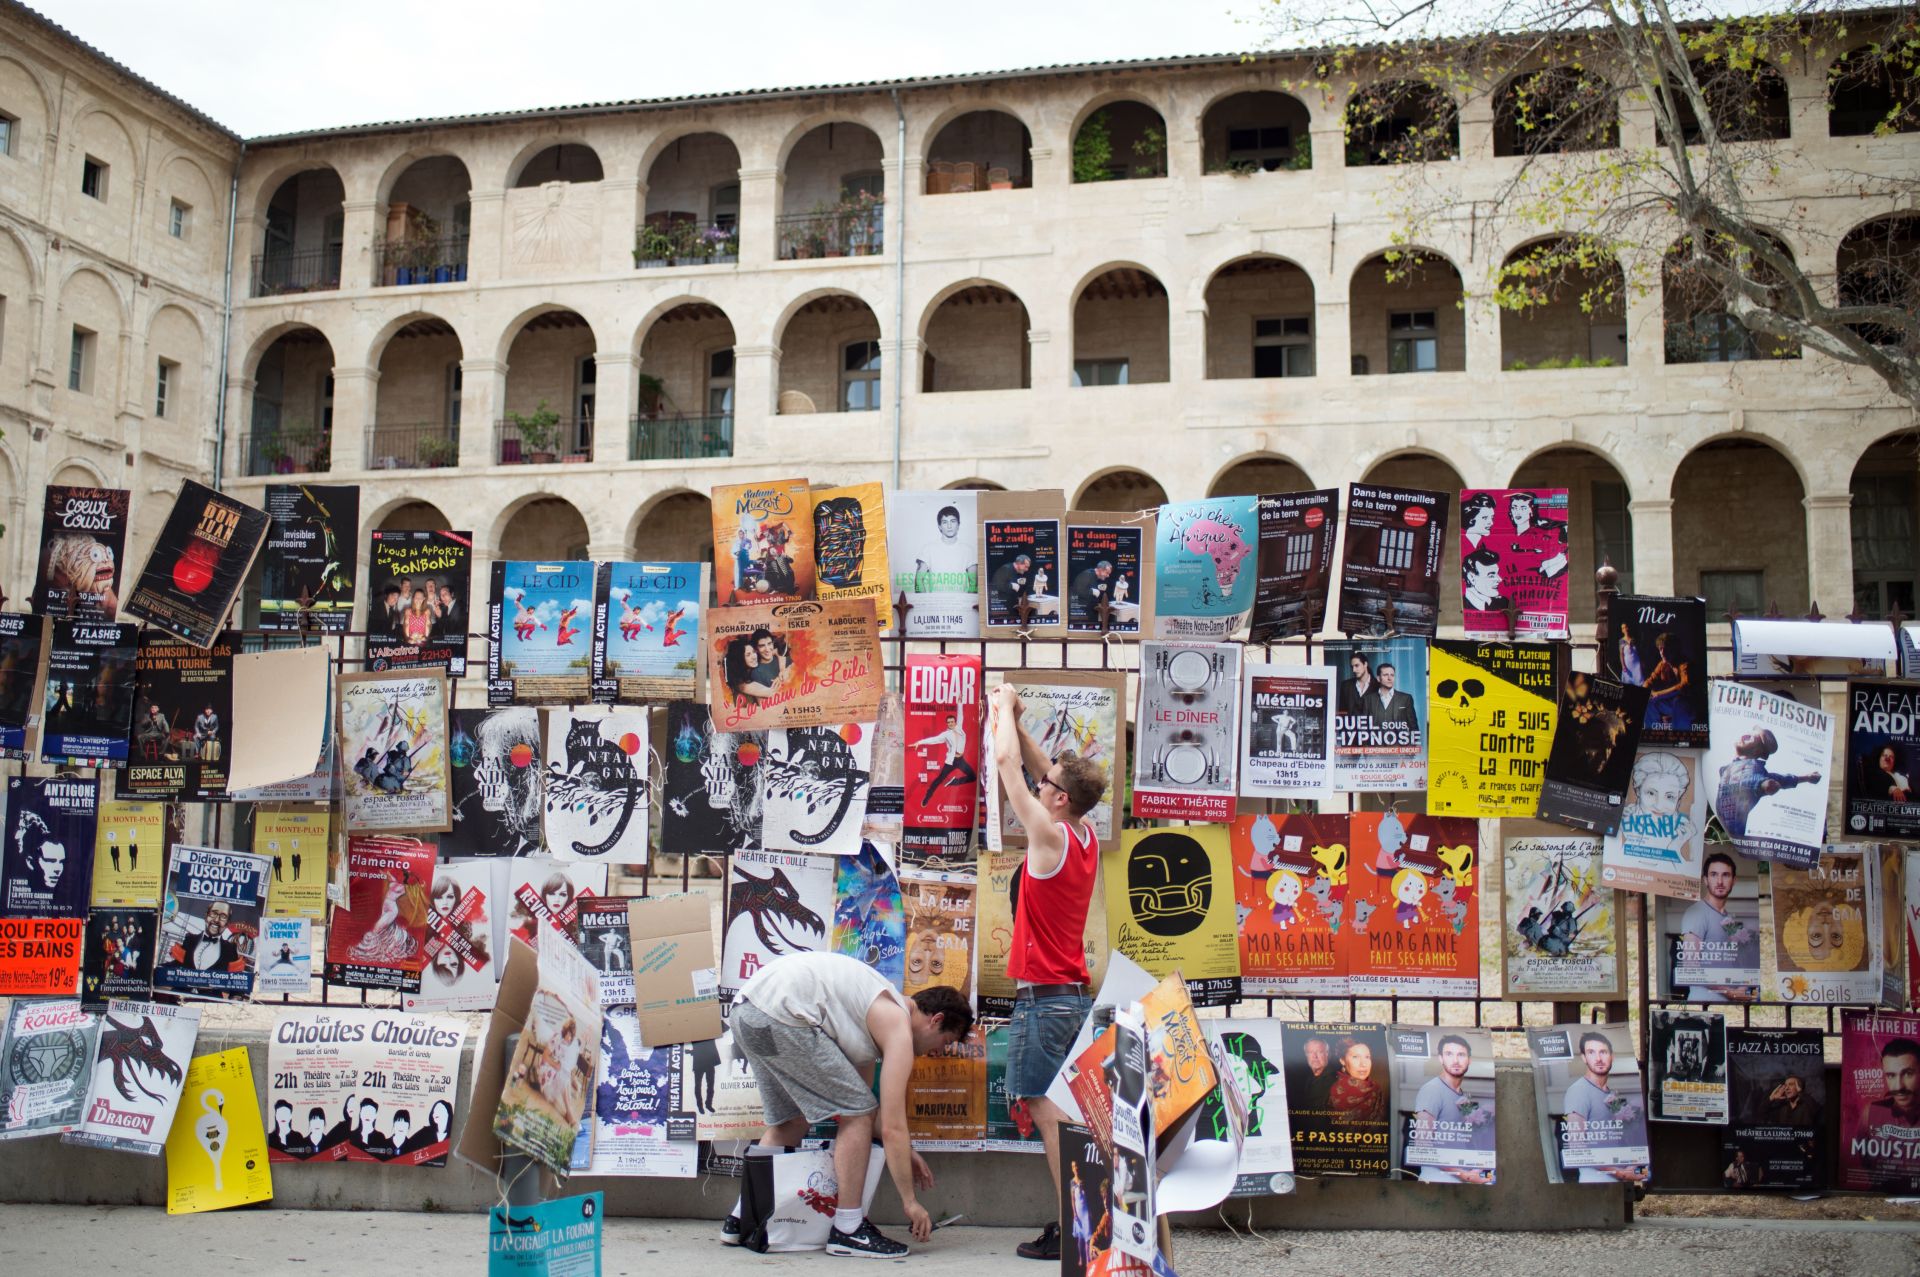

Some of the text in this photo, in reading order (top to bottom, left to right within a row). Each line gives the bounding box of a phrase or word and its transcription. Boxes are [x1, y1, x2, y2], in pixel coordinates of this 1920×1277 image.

[1261, 496, 1329, 509] Dans les entrailles
[1353, 488, 1436, 505] Dans les entrailles
[1352, 500, 1397, 511] de la terre
[203, 503, 240, 529] DOM
[1273, 511, 1280, 519] la
[1282, 510, 1299, 518] terre
[197, 518, 235, 542] JUAN
[284, 530, 316, 539] invisibles
[992, 526, 1001, 535] la
[1003, 526, 1034, 535] danse
[268, 540, 307, 549] provisoires
[990, 535, 1035, 544] de zadig
[523, 575, 580, 588] LE CID
[629, 576, 687, 589] LE CID
[896, 572, 976, 586] LES ESCARGOTS
[1503, 575, 1562, 589] CANTATRICE
[822, 584, 886, 602] BIENFAISANTS
[828, 617, 867, 626] KABOUCHE
[1638, 606, 1676, 625] Mer
[715, 623, 770, 634] ASGHARZADEH
[788, 621, 810, 629] ISKER
[1174, 619, 1225, 632] Théâtre Notre-Dame
[72, 628, 78, 638] 7
[80, 628, 121, 640] FLASHES
[490, 604, 501, 680] THEATRE ACTUEL
[594, 603, 607, 679] THEATRE ACTUEL
[369, 646, 420, 658] L'Albatros
[421, 649, 452, 661] 22H30
[910, 665, 976, 705] EDGAR
[1256, 693, 1323, 708] Métallos
[1717, 684, 1828, 733] TOM POISSON
[1156, 708, 1218, 723] LE DÎNER
[1335, 731, 1421, 747] HYPNOSE
[1269, 750, 1321, 759] Dégraisseurs
[1250, 759, 1326, 771] Chapeau d'Ebène
[1409, 761, 1426, 769] 20H
[130, 767, 184, 780] ESPACE ALYA
[1276, 771, 1299, 779] 13h15
[44, 784, 95, 797] ANTIGONE
[49, 797, 94, 808] DANS LA TÊTE
[1182, 797, 1227, 808] THÉÂTRE
[113, 815, 160, 824] MONTE-PLATS
[275, 826, 325, 834] MONTE-PLATS
[190, 853, 252, 870] Didier Porte
[351, 855, 410, 869] Flamenco
[737, 850, 808, 868] THÉÂTRE DE L'OULLE
[188, 864, 250, 884] JUSQU'AU
[1830, 870, 1859, 882] CLEF
[1847, 889, 1861, 900] DE
[920, 896, 972, 912] LA CLEF
[34, 923, 80, 938] FROU
[269, 922, 302, 931] ROMAIN
[954, 918, 970, 932] DE
[270, 931, 300, 940] HENRY
[1369, 931, 1457, 953] MORGANE
[1247, 932, 1335, 953] MORGANE
[1676, 941, 1738, 951] MA FOLLE
[23, 942, 74, 958] BAINS
[1676, 951, 1722, 961] OTARIE
[1249, 951, 1336, 966] FAIT SES GAMMES
[1370, 951, 1458, 966] FAIT SES GAMMES
[1207, 979, 1233, 991] 17h15
[1781, 977, 1851, 1001] 3 soleils
[111, 1000, 177, 1018] THÉÂTRE DE L'OULLE
[23, 1011, 90, 1030] ROUGES
[316, 1015, 330, 1023] Les
[411, 1018, 424, 1026] Les
[278, 1021, 365, 1043] Choutes
[371, 1020, 460, 1047] Choutes
[1287, 1023, 1319, 1031] THÉÂTRE
[1331, 1023, 1377, 1032] L'ÉTINCELLE
[1736, 1041, 1821, 1054] JAZZ À 3 DOIGTS
[275, 1071, 330, 1088] 21h Théâtre
[363, 1071, 420, 1088] 21h Théâtre
[621, 1070, 651, 1079] lapins
[1853, 1068, 1883, 1080] 19H00
[429, 1084, 446, 1093] juillet
[617, 1083, 657, 1098] toujours
[915, 1103, 968, 1117] MARIVAUX
[94, 1107, 152, 1132] DRAGON
[1409, 1119, 1473, 1131] MA FOLLE
[1560, 1120, 1624, 1131] MA FOLLE
[1408, 1131, 1455, 1142] OTARIE
[1561, 1131, 1608, 1142] OTARIE
[1350, 1159, 1388, 1170] 13H40
[773, 1216, 808, 1225] carrefour.fr
[552, 1222, 595, 1244] LA FOURMI
